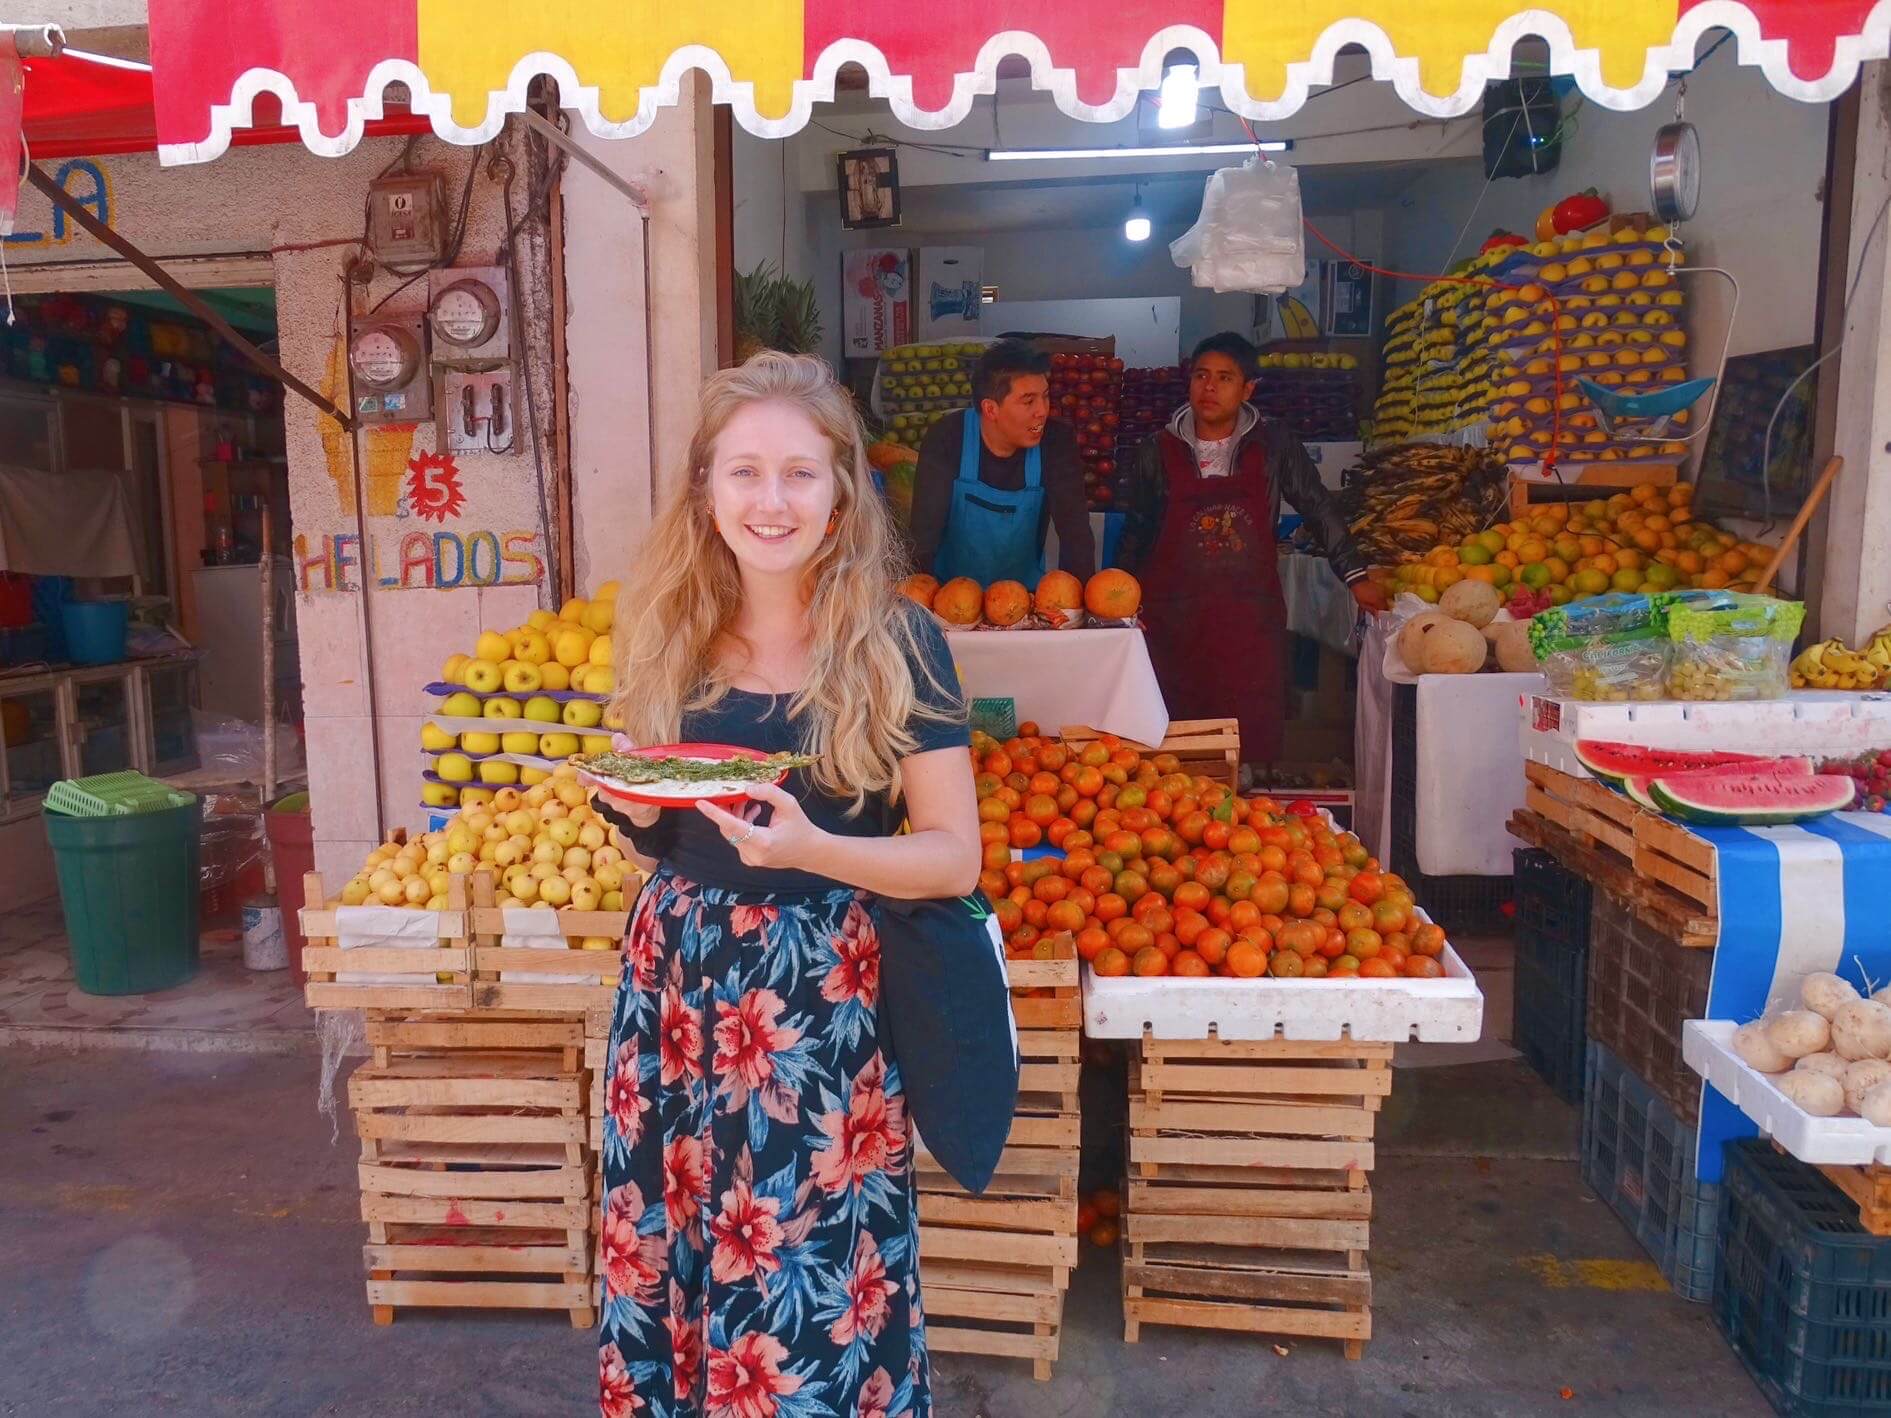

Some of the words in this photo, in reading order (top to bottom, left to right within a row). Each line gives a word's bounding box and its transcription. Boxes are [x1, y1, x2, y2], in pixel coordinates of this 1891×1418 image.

[872, 293, 884, 351] MANZANAS
[424, 467, 450, 507] 5
[294, 530, 545, 592] HELADOS
